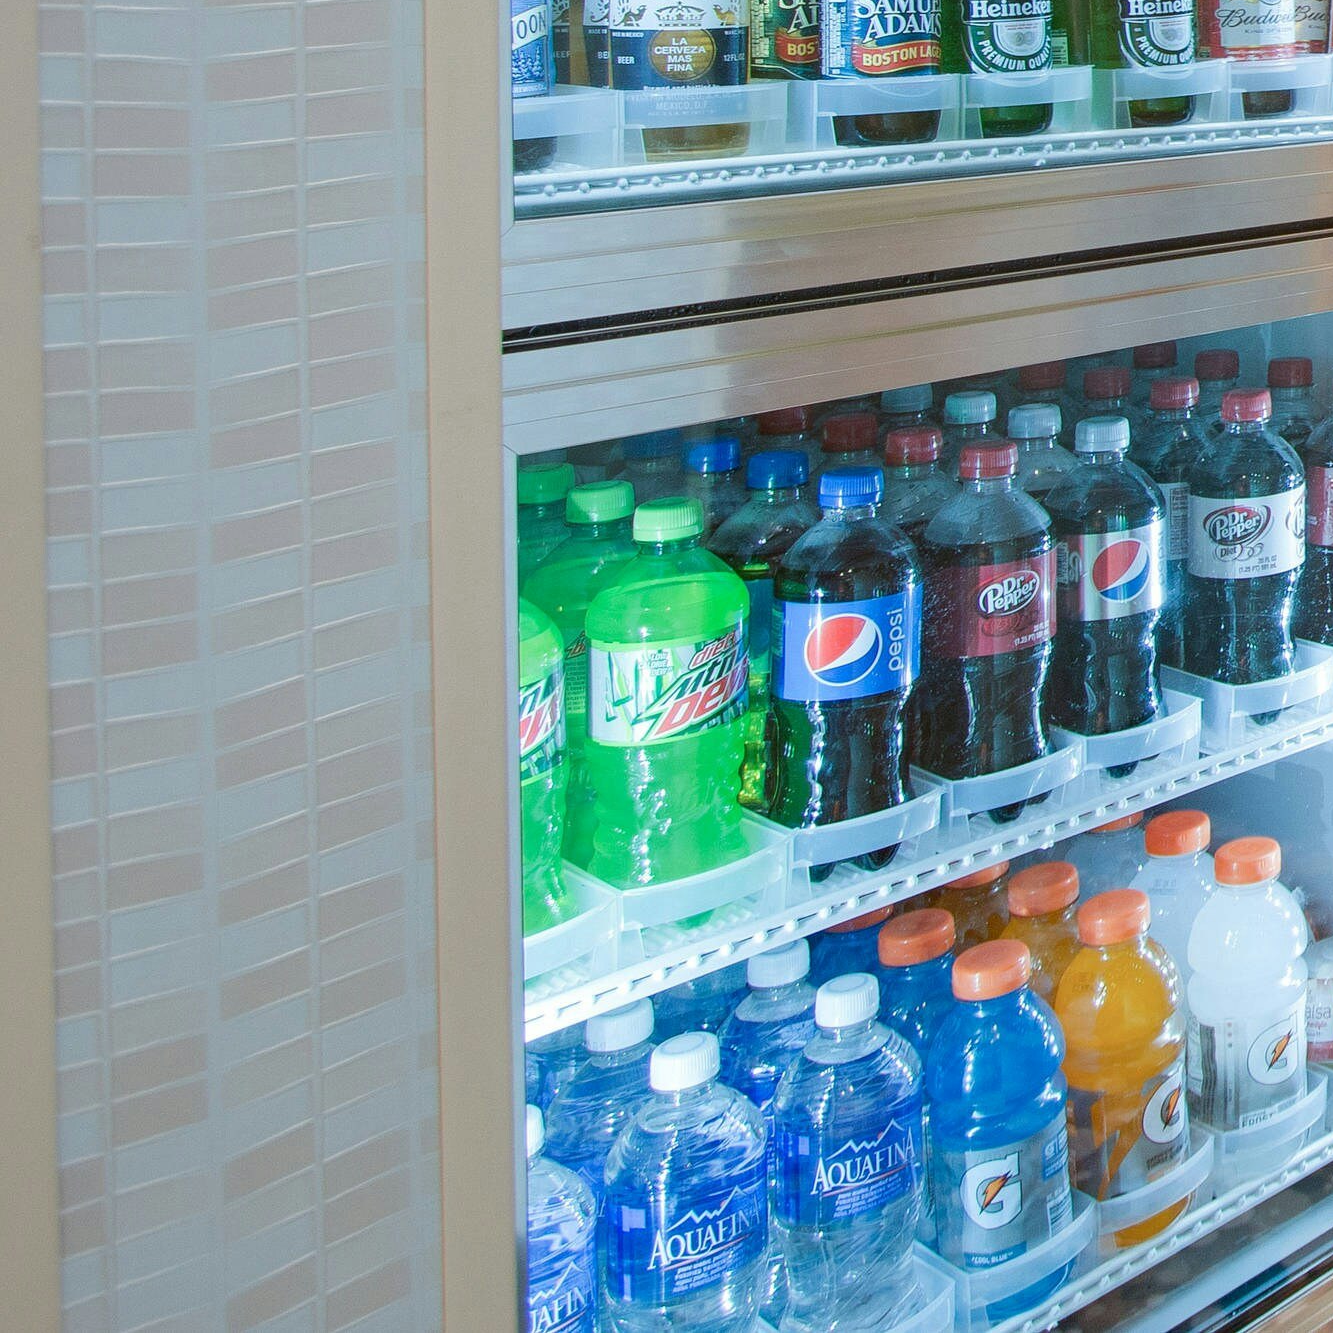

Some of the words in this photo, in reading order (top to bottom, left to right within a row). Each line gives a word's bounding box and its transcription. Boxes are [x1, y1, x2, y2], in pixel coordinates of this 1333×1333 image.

[512, 9, 548, 41] OON
[862, 13, 942, 45] ADAMS
[654, 45, 706, 55] CERVEZA
[671, 37, 688, 46] LA
[787, 41, 817, 56] BOS
[1135, 35, 1178, 65] PREMIUM
[617, 56, 635, 65] BEER
[667, 55, 693, 64] MAS
[861, 45, 918, 67] BOSTON
[919, 44, 942, 60] LAGE
[978, 39, 1027, 71] PREMIUM
[666, 63, 693, 73] FINA
[1214, 515, 1261, 541] Pepper
[1226, 511, 1248, 524] Dr
[1220, 546, 1238, 558] Diet
[987, 577, 1037, 614] Pepper
[1003, 575, 1025, 596] Dr
[887, 607, 903, 672] pepsi
[1303, 1006, 1332, 1019] alsa
[810, 1125, 916, 1196] AQUAFINA
[960, 1151, 1022, 1230] G
